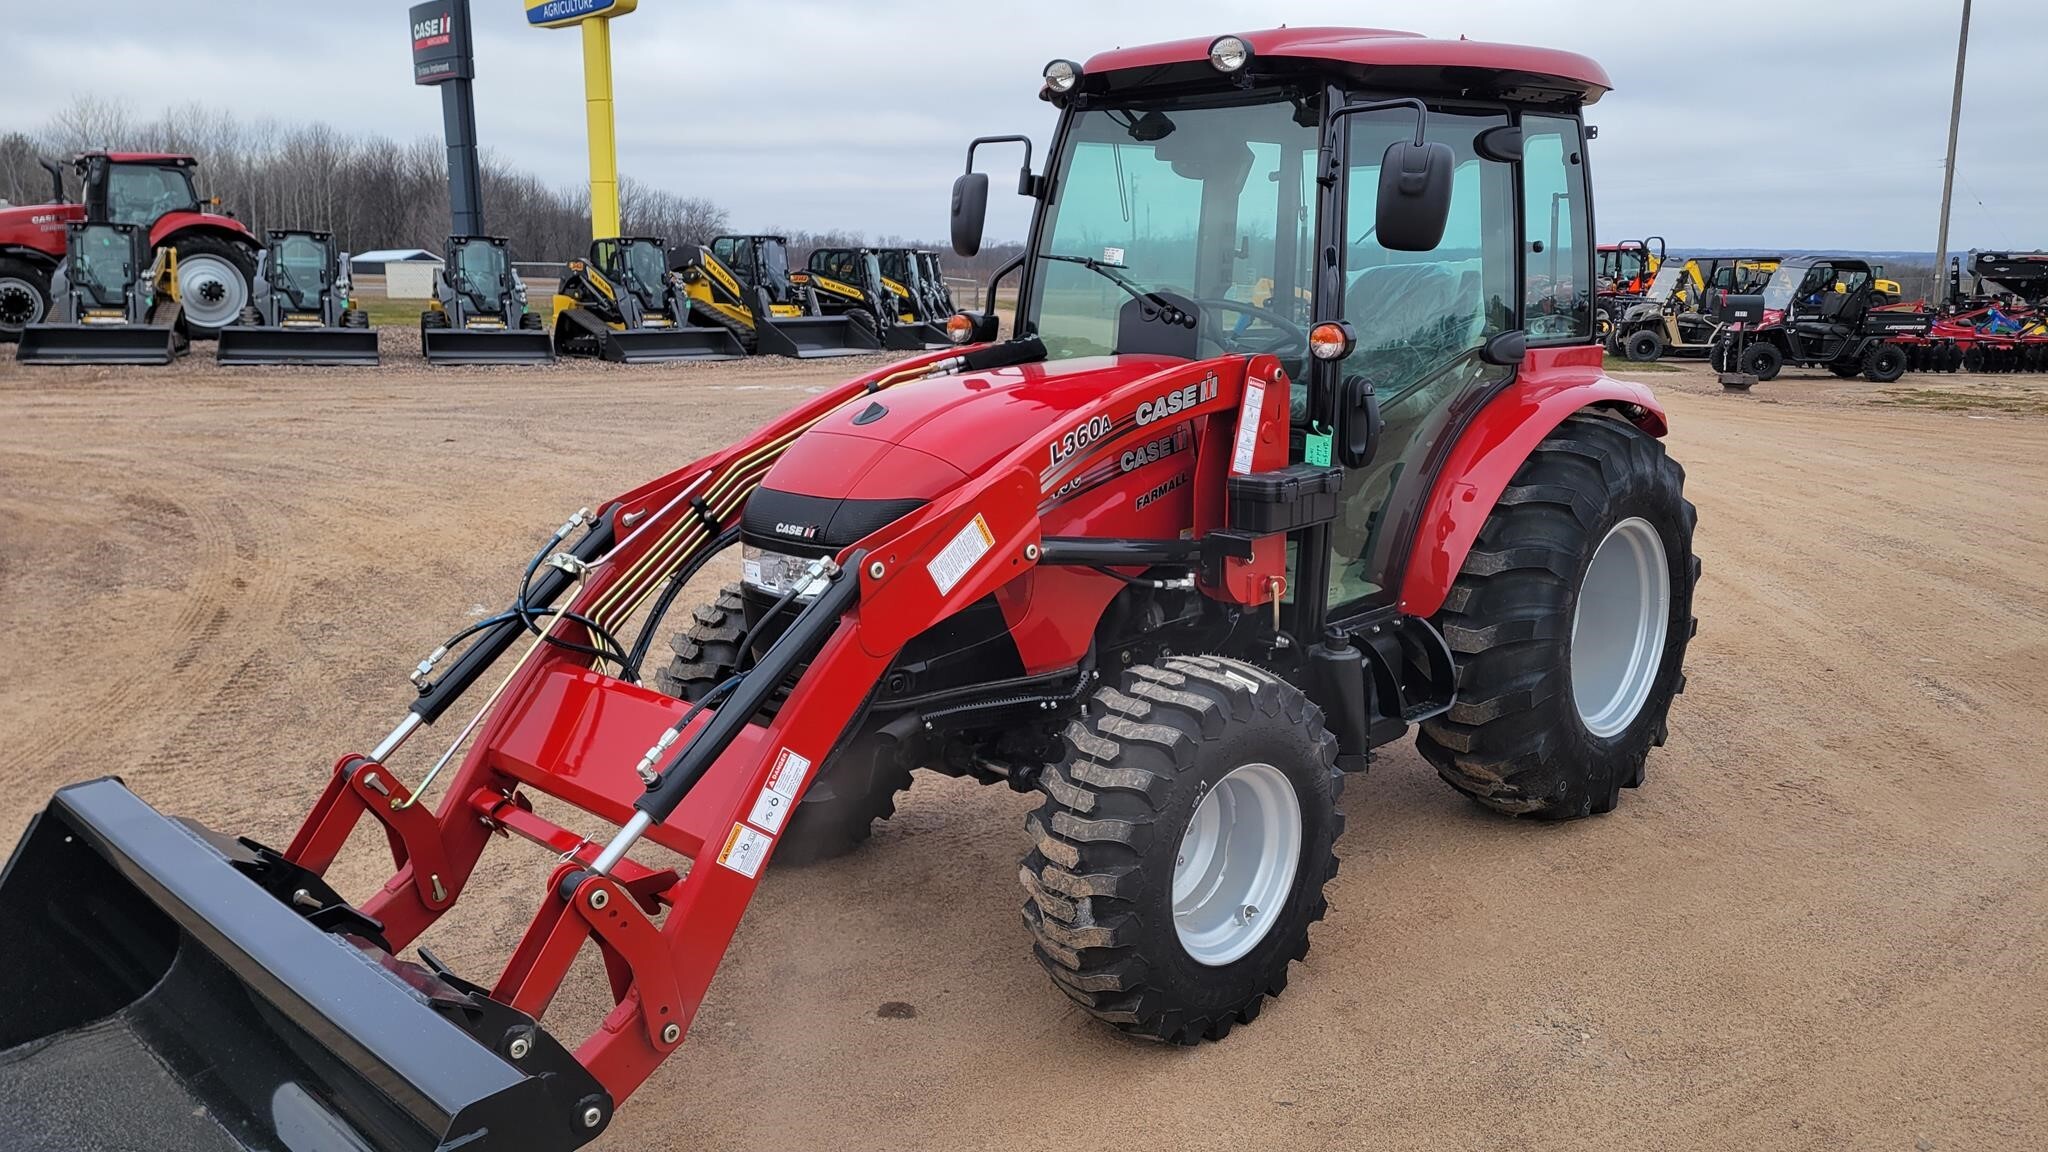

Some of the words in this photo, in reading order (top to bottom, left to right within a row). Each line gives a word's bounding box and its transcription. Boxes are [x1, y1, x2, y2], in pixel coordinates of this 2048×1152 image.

[543, 0, 593, 17] AGRICULTURE
[414, 18, 438, 40] CASE
[1050, 413, 1113, 468] L360A
[1135, 384, 1198, 426] CASE
[1120, 436, 1171, 472] CASE
[1136, 472, 1190, 512] FARMALL
[776, 523, 803, 536] CASE
[772, 753, 788, 780] DANGER
